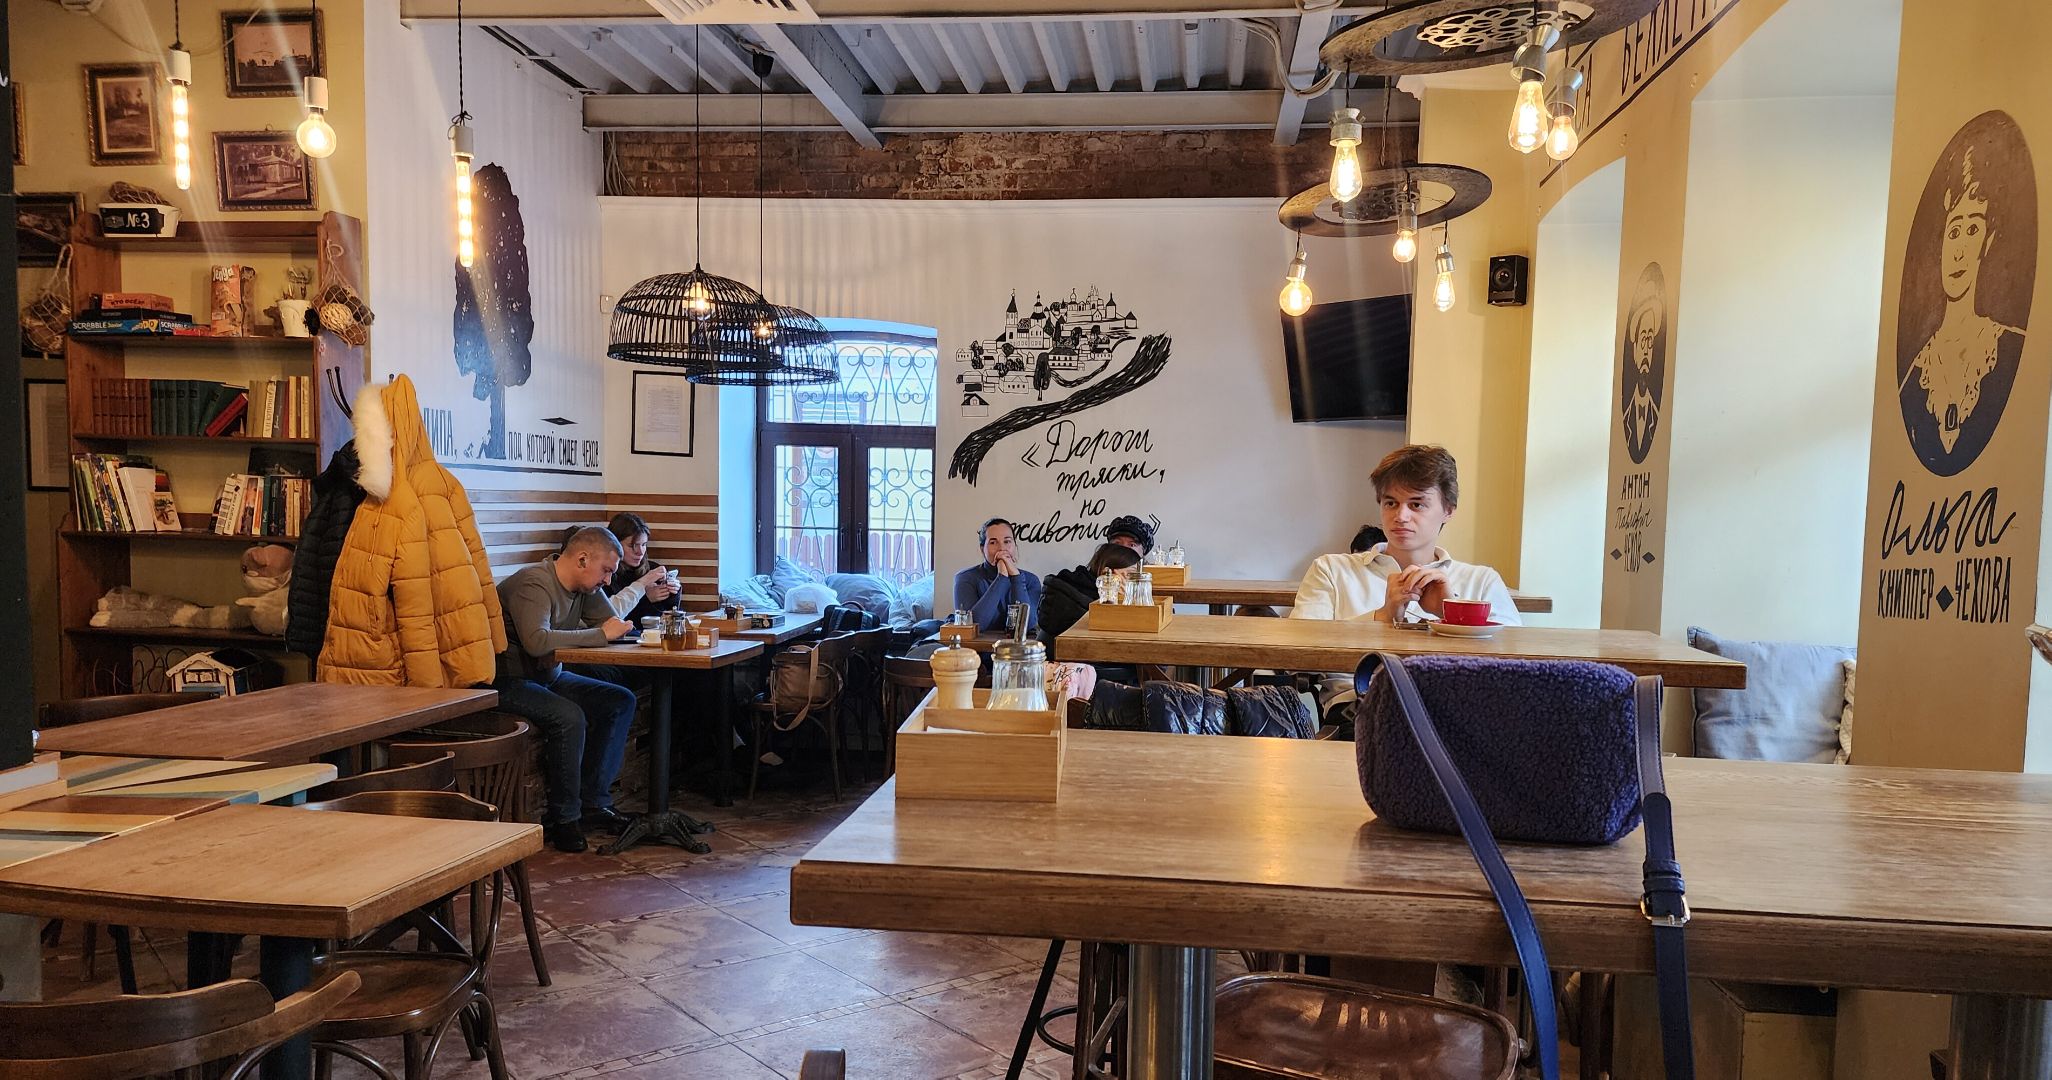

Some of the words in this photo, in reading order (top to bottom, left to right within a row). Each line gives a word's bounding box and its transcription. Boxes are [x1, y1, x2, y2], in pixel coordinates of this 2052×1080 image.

[73, 322, 107, 330] SCRABBLE
[508, 431, 523, 461] ПОД
[526, 431, 555, 464] КОТОРОЙ
[582, 439, 599, 468] ЧЕХОВ
[1056, 461, 1166, 500] тряски,
[1621, 471, 1651, 500] АНТОН
[1080, 499, 1107, 519] но
[1877, 567, 1935, 621] КНИППЕР
[1955, 556, 2012, 624] ЧЕХОВА
